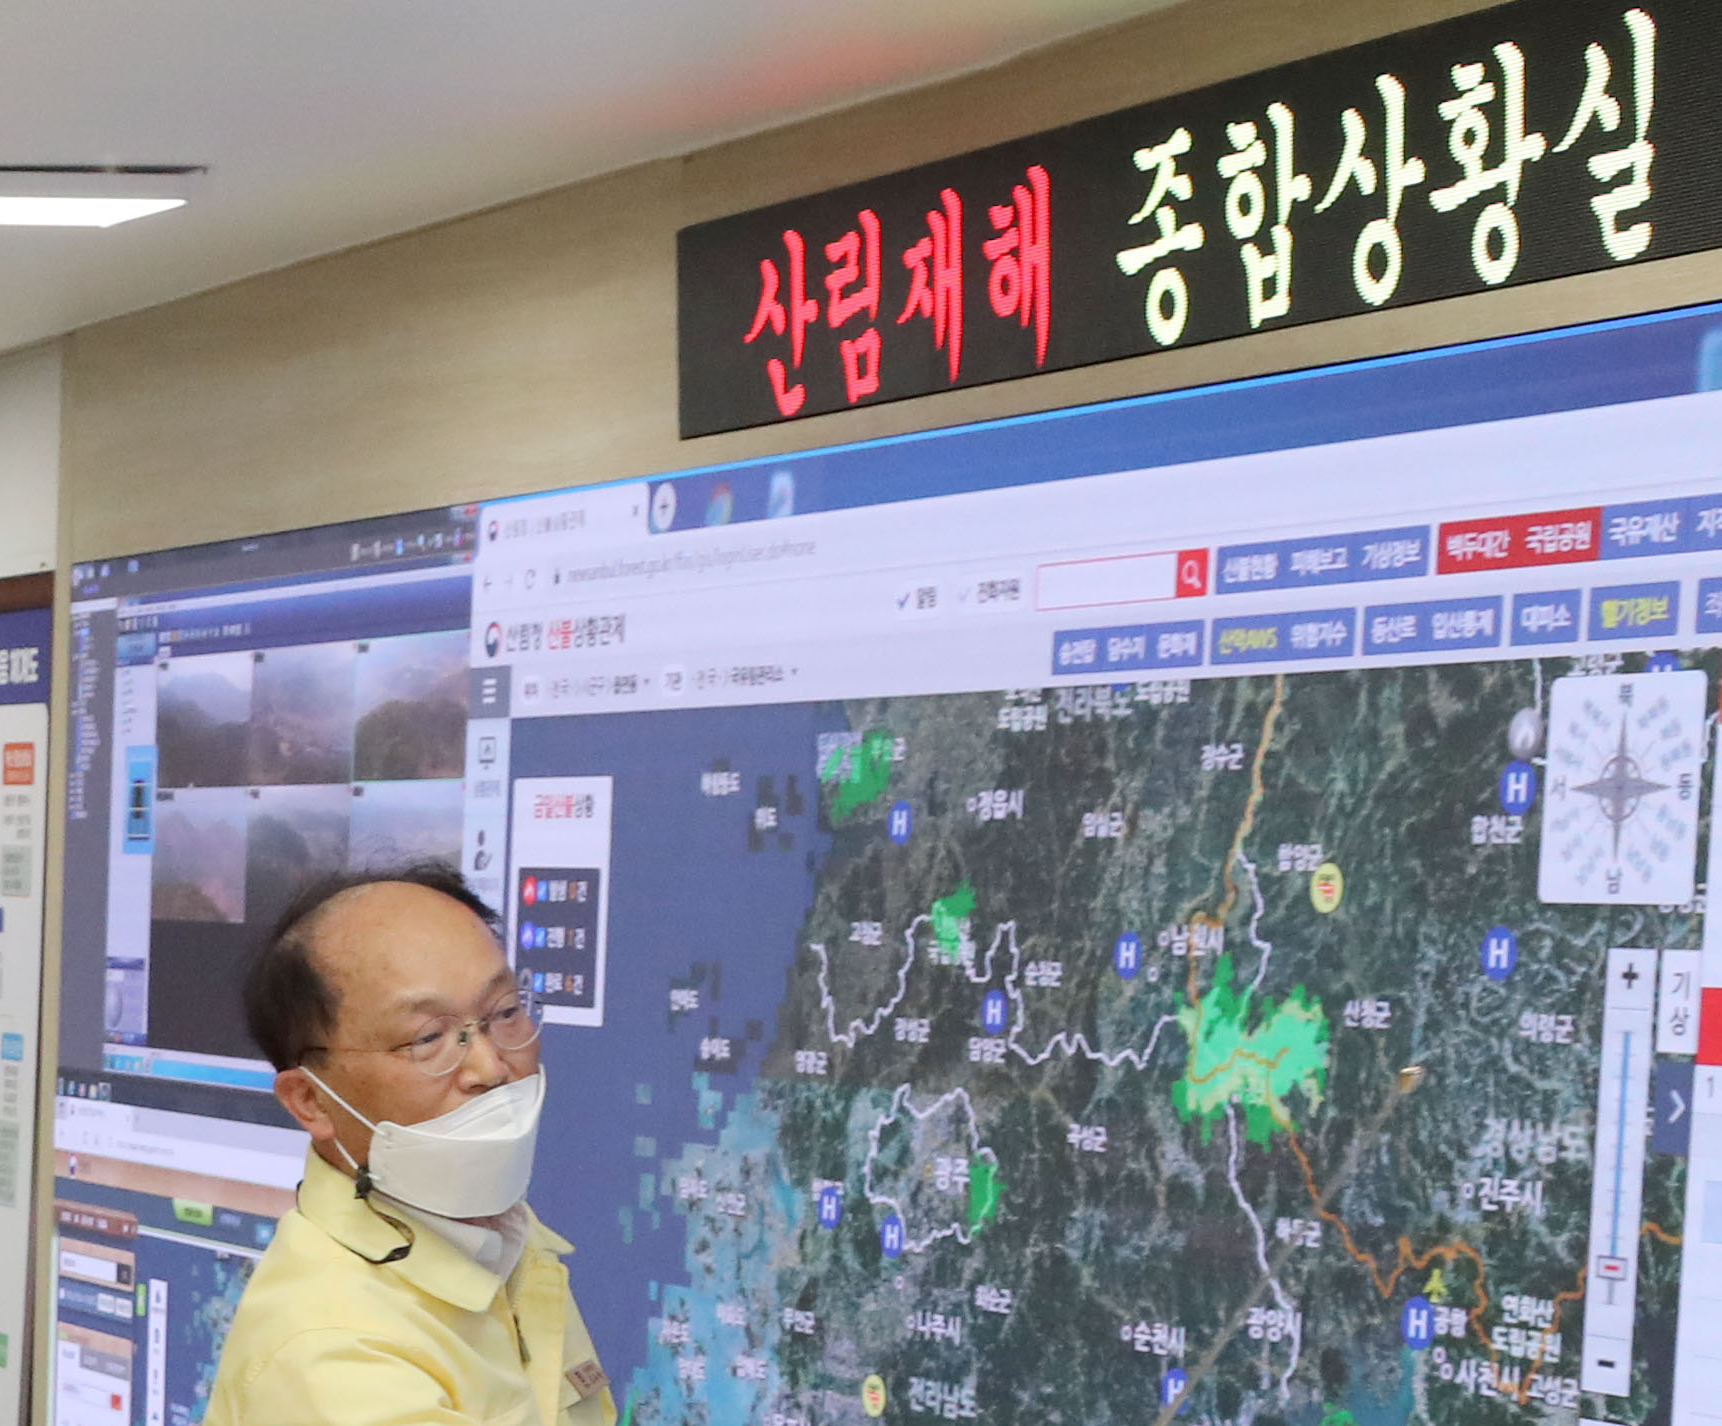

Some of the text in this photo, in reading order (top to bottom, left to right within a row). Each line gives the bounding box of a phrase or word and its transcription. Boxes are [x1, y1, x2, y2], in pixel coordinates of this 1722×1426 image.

[745, 7, 1657, 418] 산림재해 종합상황실
[1360, 538, 1422, 570] 기상정보
[1445, 510, 1682, 562] 백두대간 국립공원 국유재산
[1370, 614, 1418, 644] 등산로
[1520, 603, 1573, 633] 대피소
[1600, 596, 1670, 629] 헬기정보
[506, 613, 626, 653] 산림청 산불상황관제
[977, 788, 1026, 821] 정읍시
[1678, 772, 1694, 800] 동
[1469, 815, 1523, 846] 합천군
[1668, 970, 1693, 1037] 기상
[1517, 1010, 1577, 1045] 의령군
[1482, 1115, 1591, 1164] 경상남도
[1479, 1176, 1545, 1218] 진주시
[1491, 1326, 1563, 1364] 도립공원
[909, 1375, 978, 1420] 전라남도
[1519, 1372, 1581, 1410] 고성군
